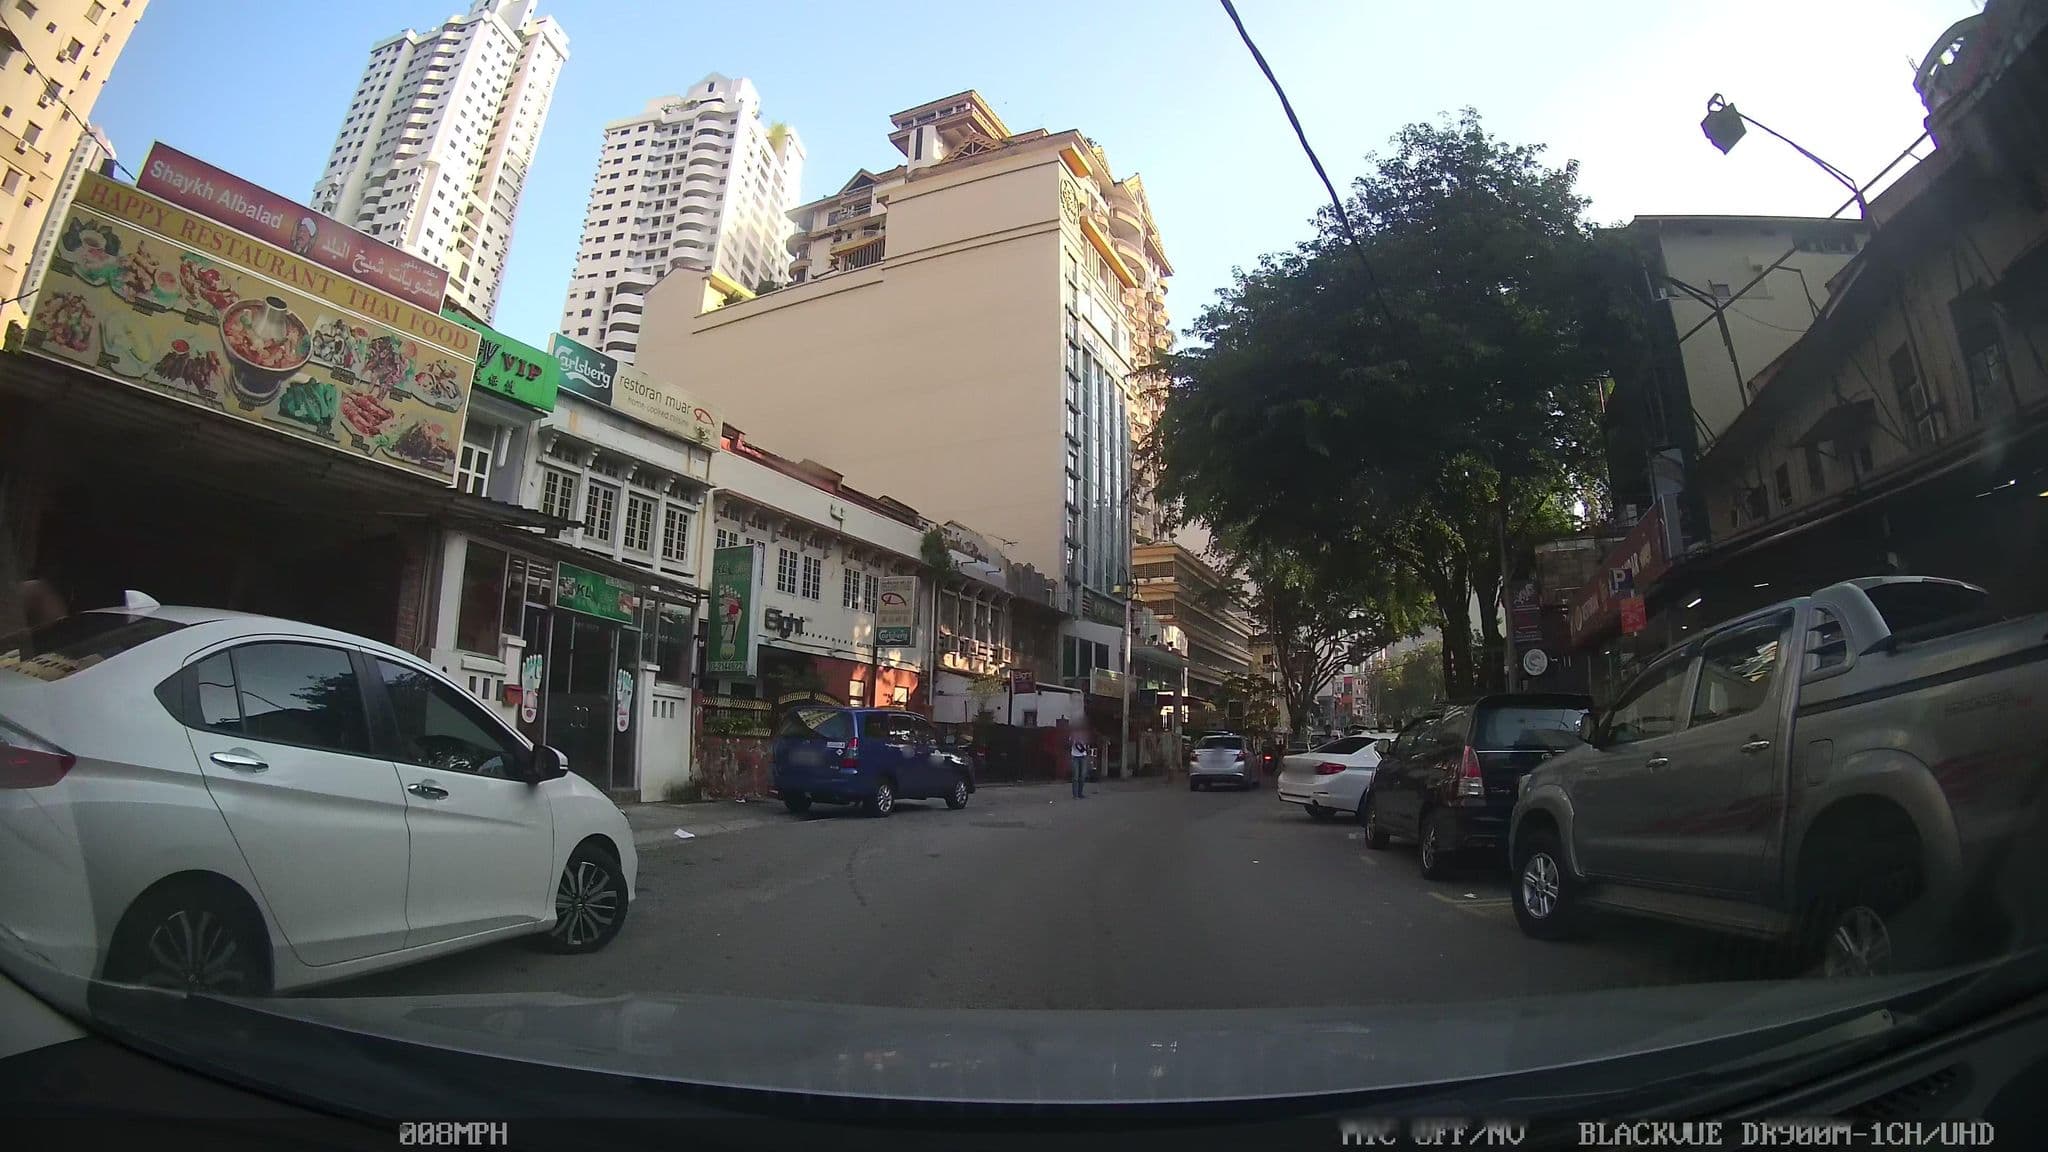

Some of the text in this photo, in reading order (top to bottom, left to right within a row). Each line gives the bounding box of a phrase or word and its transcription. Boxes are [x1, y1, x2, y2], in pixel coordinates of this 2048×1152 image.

[150, 160, 285, 230] Shaykh Albalad
[89, 182, 469, 350] HAPPY RESTAURANT THAI FOOD
[501, 352, 543, 381] VIP
[555, 345, 611, 389] Carlsberg
[620, 376, 692, 414] restoran muar
